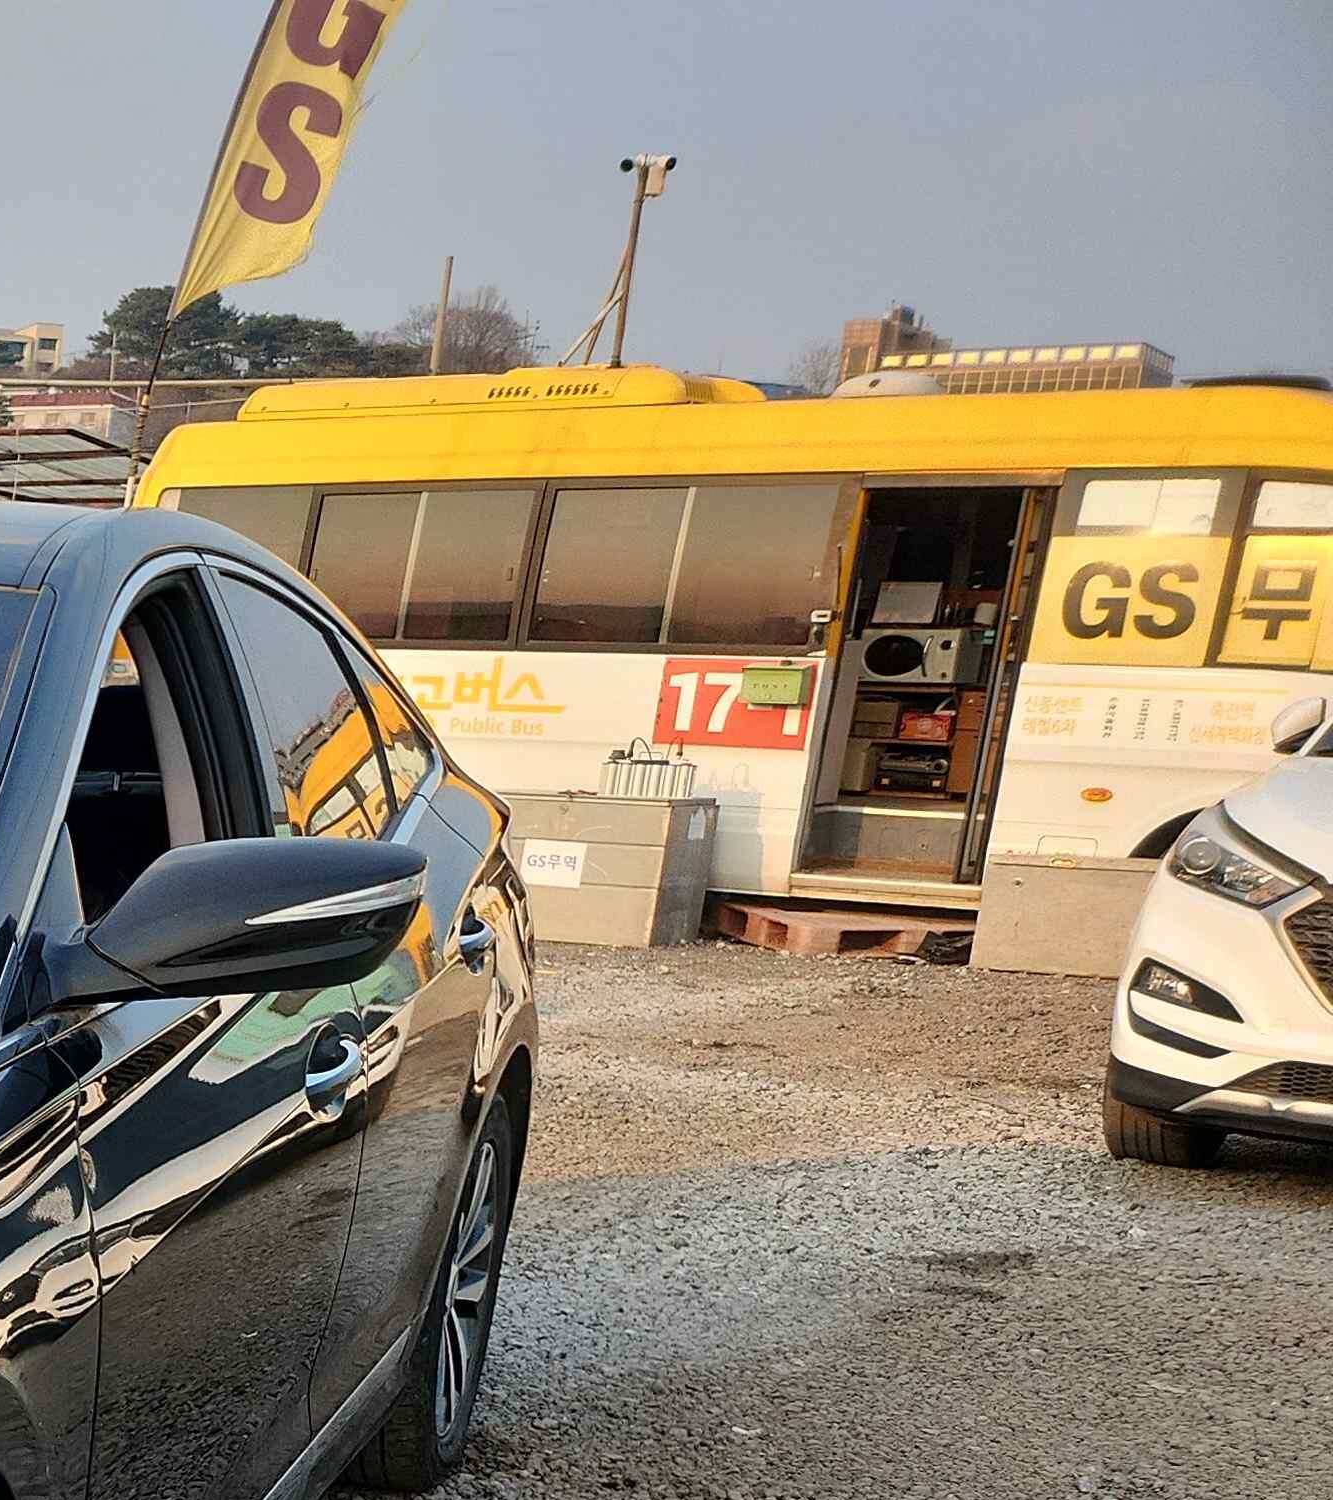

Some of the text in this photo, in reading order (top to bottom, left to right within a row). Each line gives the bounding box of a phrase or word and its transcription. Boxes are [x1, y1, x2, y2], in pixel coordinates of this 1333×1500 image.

[1062, 561, 1200, 640] GS
[399, 655, 566, 713] 고버스
[449, 717, 506, 734] Public
[511, 718, 545, 736] Bus
[527, 854, 577, 871] GS무역
